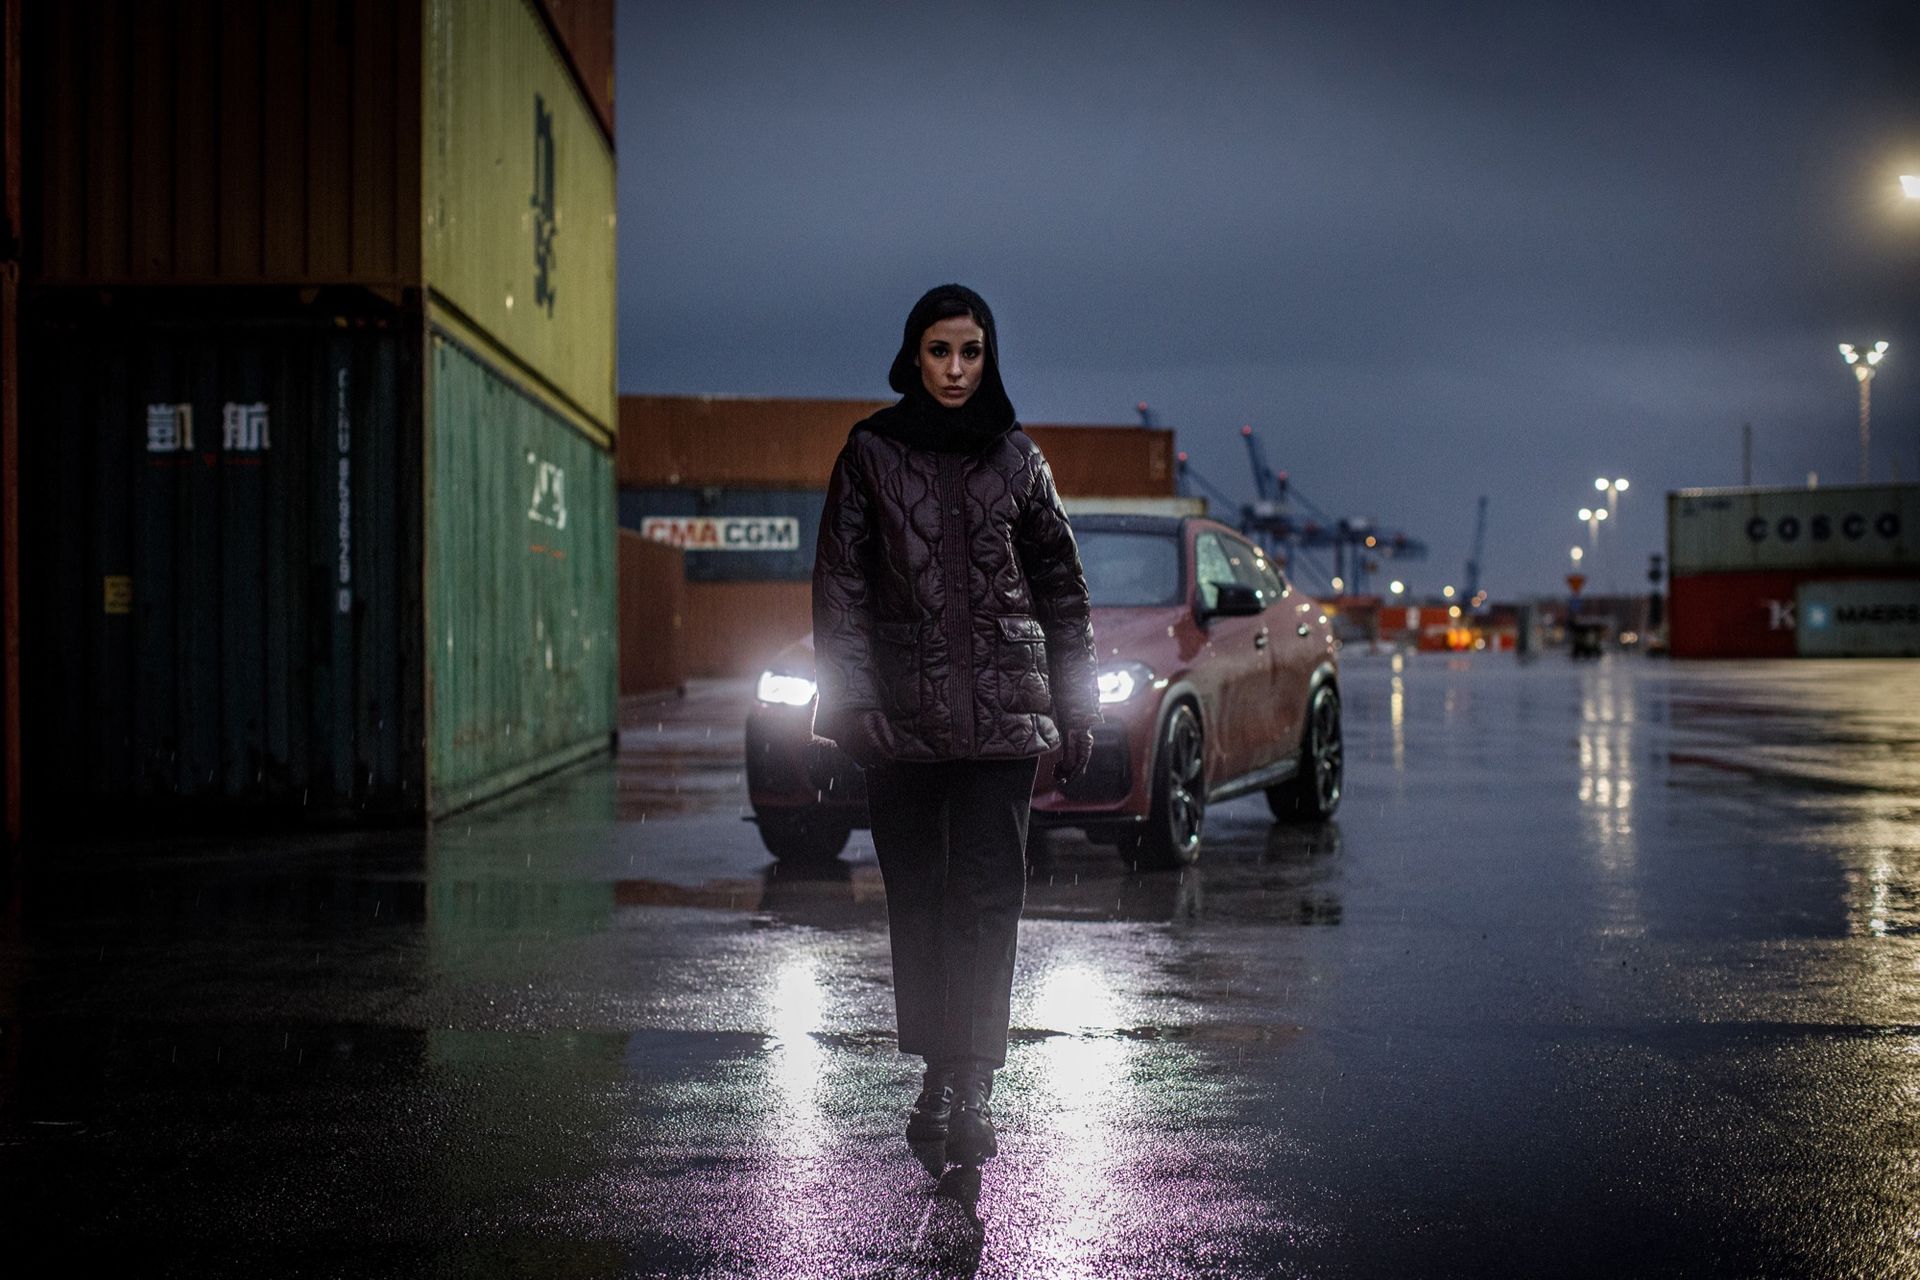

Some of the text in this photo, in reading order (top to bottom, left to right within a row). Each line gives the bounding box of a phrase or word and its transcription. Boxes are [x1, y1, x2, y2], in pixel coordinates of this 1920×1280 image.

[648, 523, 793, 545] CMA CGM
[1747, 513, 1899, 542] COSCO
[1838, 604, 1920, 623] MAERS
